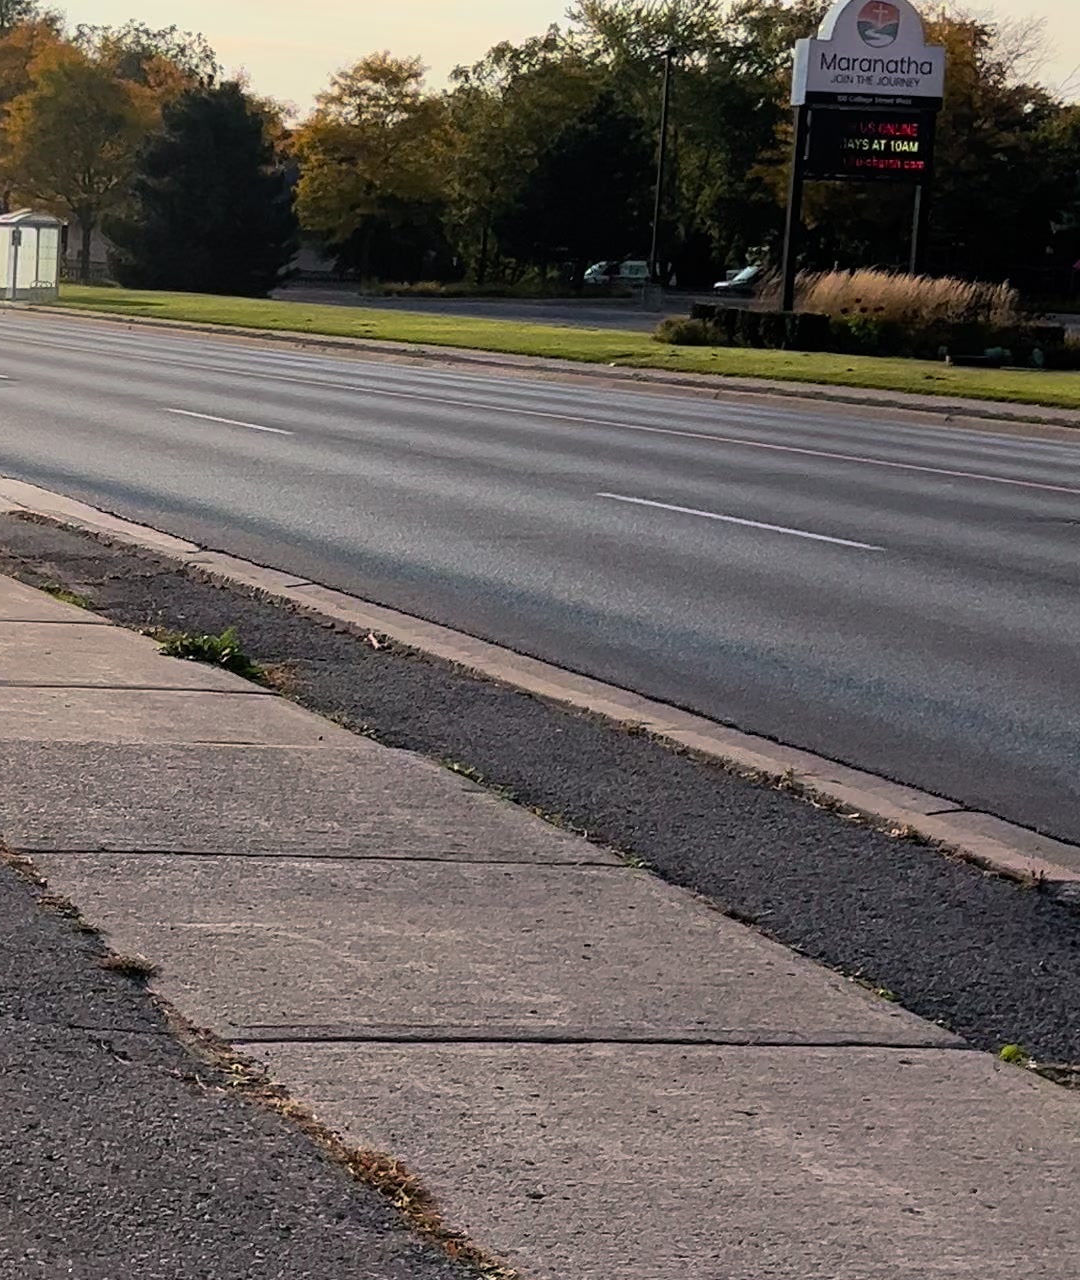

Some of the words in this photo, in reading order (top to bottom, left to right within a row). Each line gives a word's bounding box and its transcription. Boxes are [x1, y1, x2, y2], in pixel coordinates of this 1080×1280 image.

[820, 52, 932, 75] Maranatha
[831, 74, 853, 84] JOIN
[856, 74, 873, 86] THE
[877, 76, 920, 88] JOURNEY
[872, 140, 886, 151] AT
[891, 141, 919, 153] 10AM
